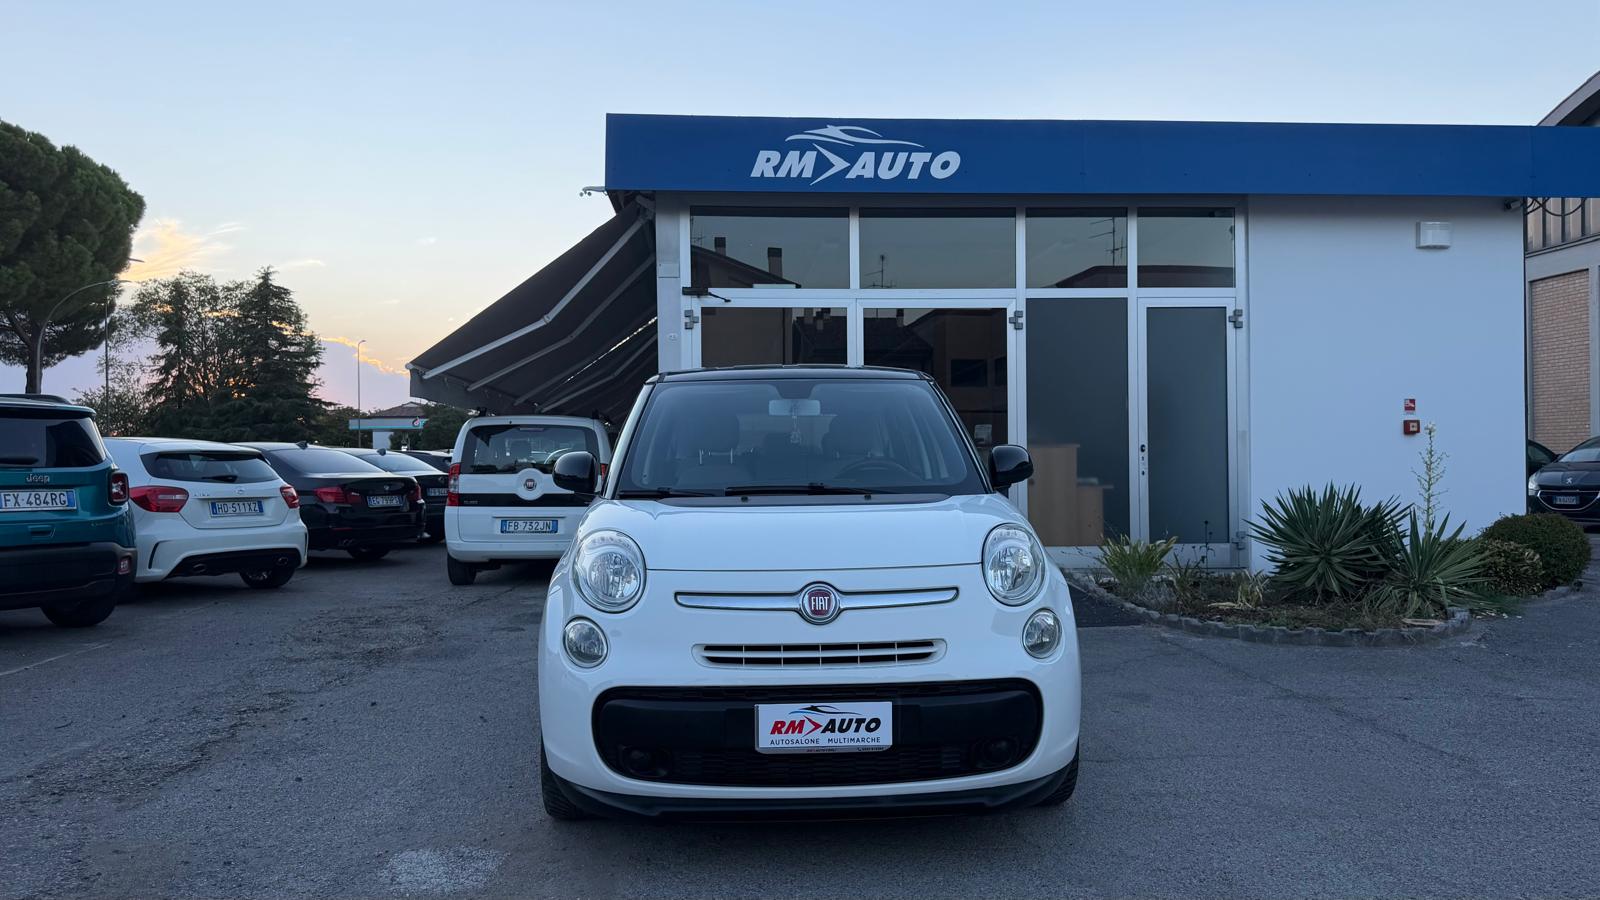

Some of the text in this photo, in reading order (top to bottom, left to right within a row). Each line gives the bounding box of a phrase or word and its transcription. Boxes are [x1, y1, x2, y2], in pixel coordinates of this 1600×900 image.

[750, 150, 961, 179] RM AUTO
[26, 473, 50, 484] Jeep
[811, 596, 829, 610] FIAT
[770, 717, 881, 735] RM AUTO
[770, 736, 881, 746] AUTOSALONE MULTIMARCHE
